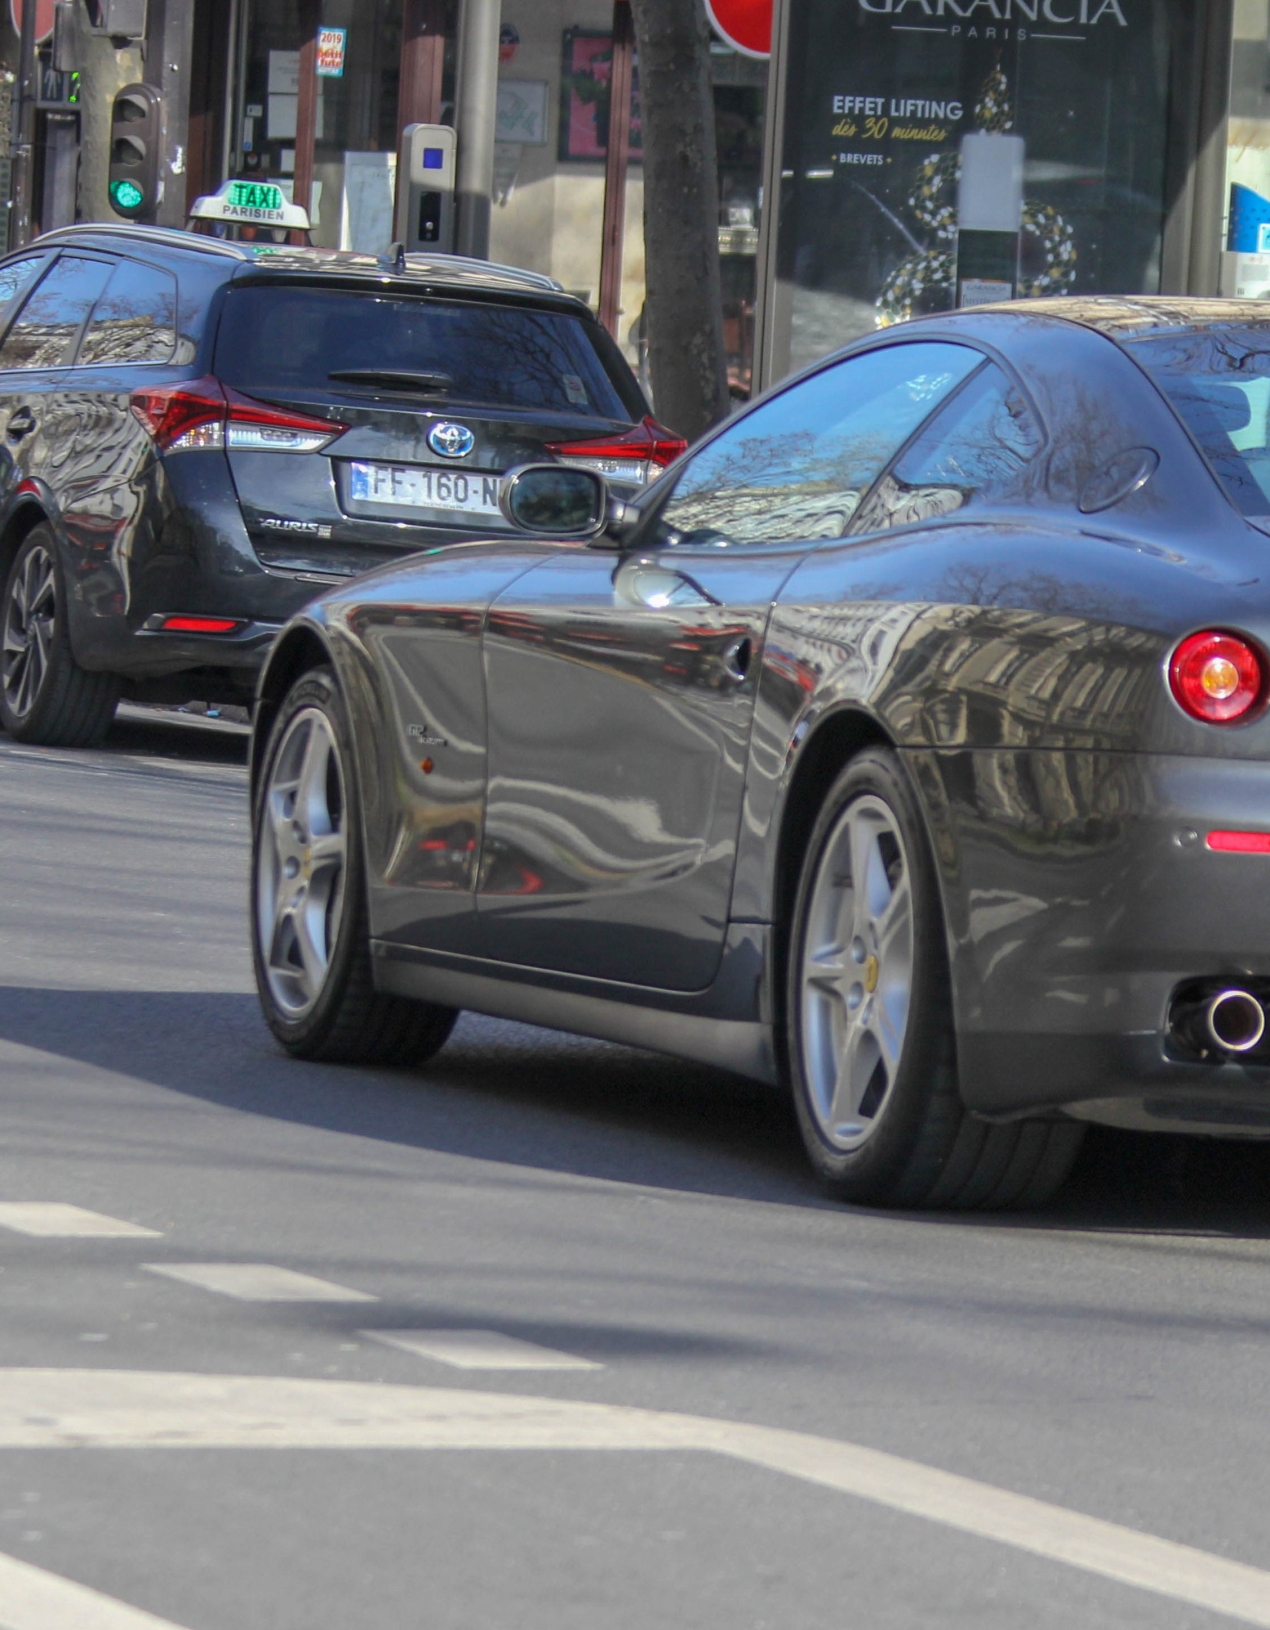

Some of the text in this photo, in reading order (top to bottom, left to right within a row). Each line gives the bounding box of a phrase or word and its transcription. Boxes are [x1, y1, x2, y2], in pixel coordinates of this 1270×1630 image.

[321, 32, 342, 43] 2019
[952, 25, 1027, 41] PARIS
[833, 95, 963, 119] EFFET LIFTING
[832, 117, 948, 140] dès 30 minutes
[840, 153, 883, 165] BREVETS
[233, 183, 277, 208] TAXI
[222, 205, 284, 220] PARISIEN
[373, 466, 499, 507] FF-160-N
[261, 519, 318, 532] AURIS
